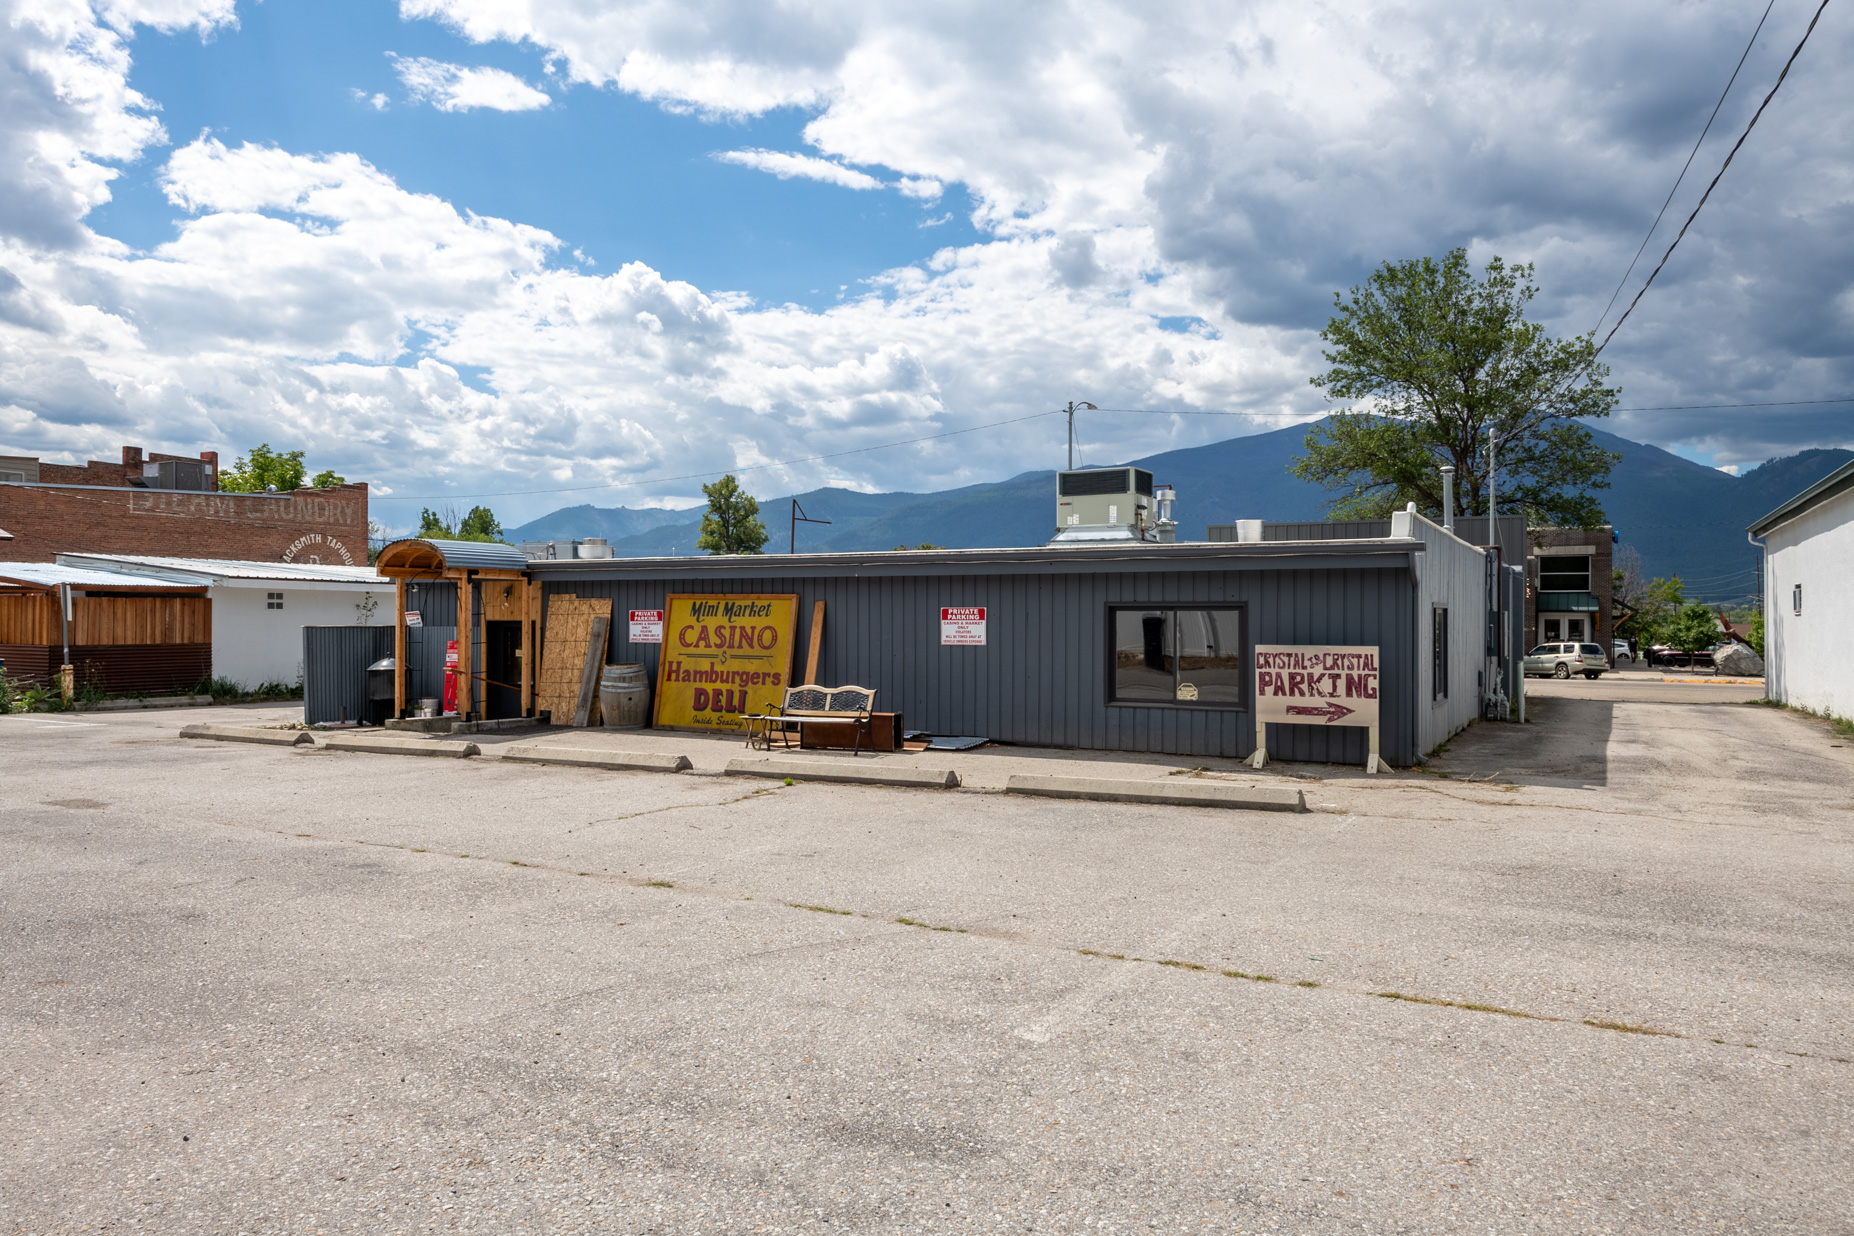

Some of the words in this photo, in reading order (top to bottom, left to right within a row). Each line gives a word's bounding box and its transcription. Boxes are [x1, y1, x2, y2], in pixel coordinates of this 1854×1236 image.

[245, 497, 355, 524] LAUNDRY
[326, 536, 355, 567] TAPHOU
[690, 601, 720, 623] Mini
[722, 601, 772, 623] Market
[678, 625, 778, 650] CASINO
[666, 660, 782, 688] Hamburgers
[1256, 652, 1308, 670] CRYSTAL
[1322, 653, 1378, 672] CRYSTAL
[1258, 671, 1378, 699] PARKING
[692, 687, 748, 714] DELI
[692, 714, 713, 725] Inside
[716, 715, 743, 729] Seating
